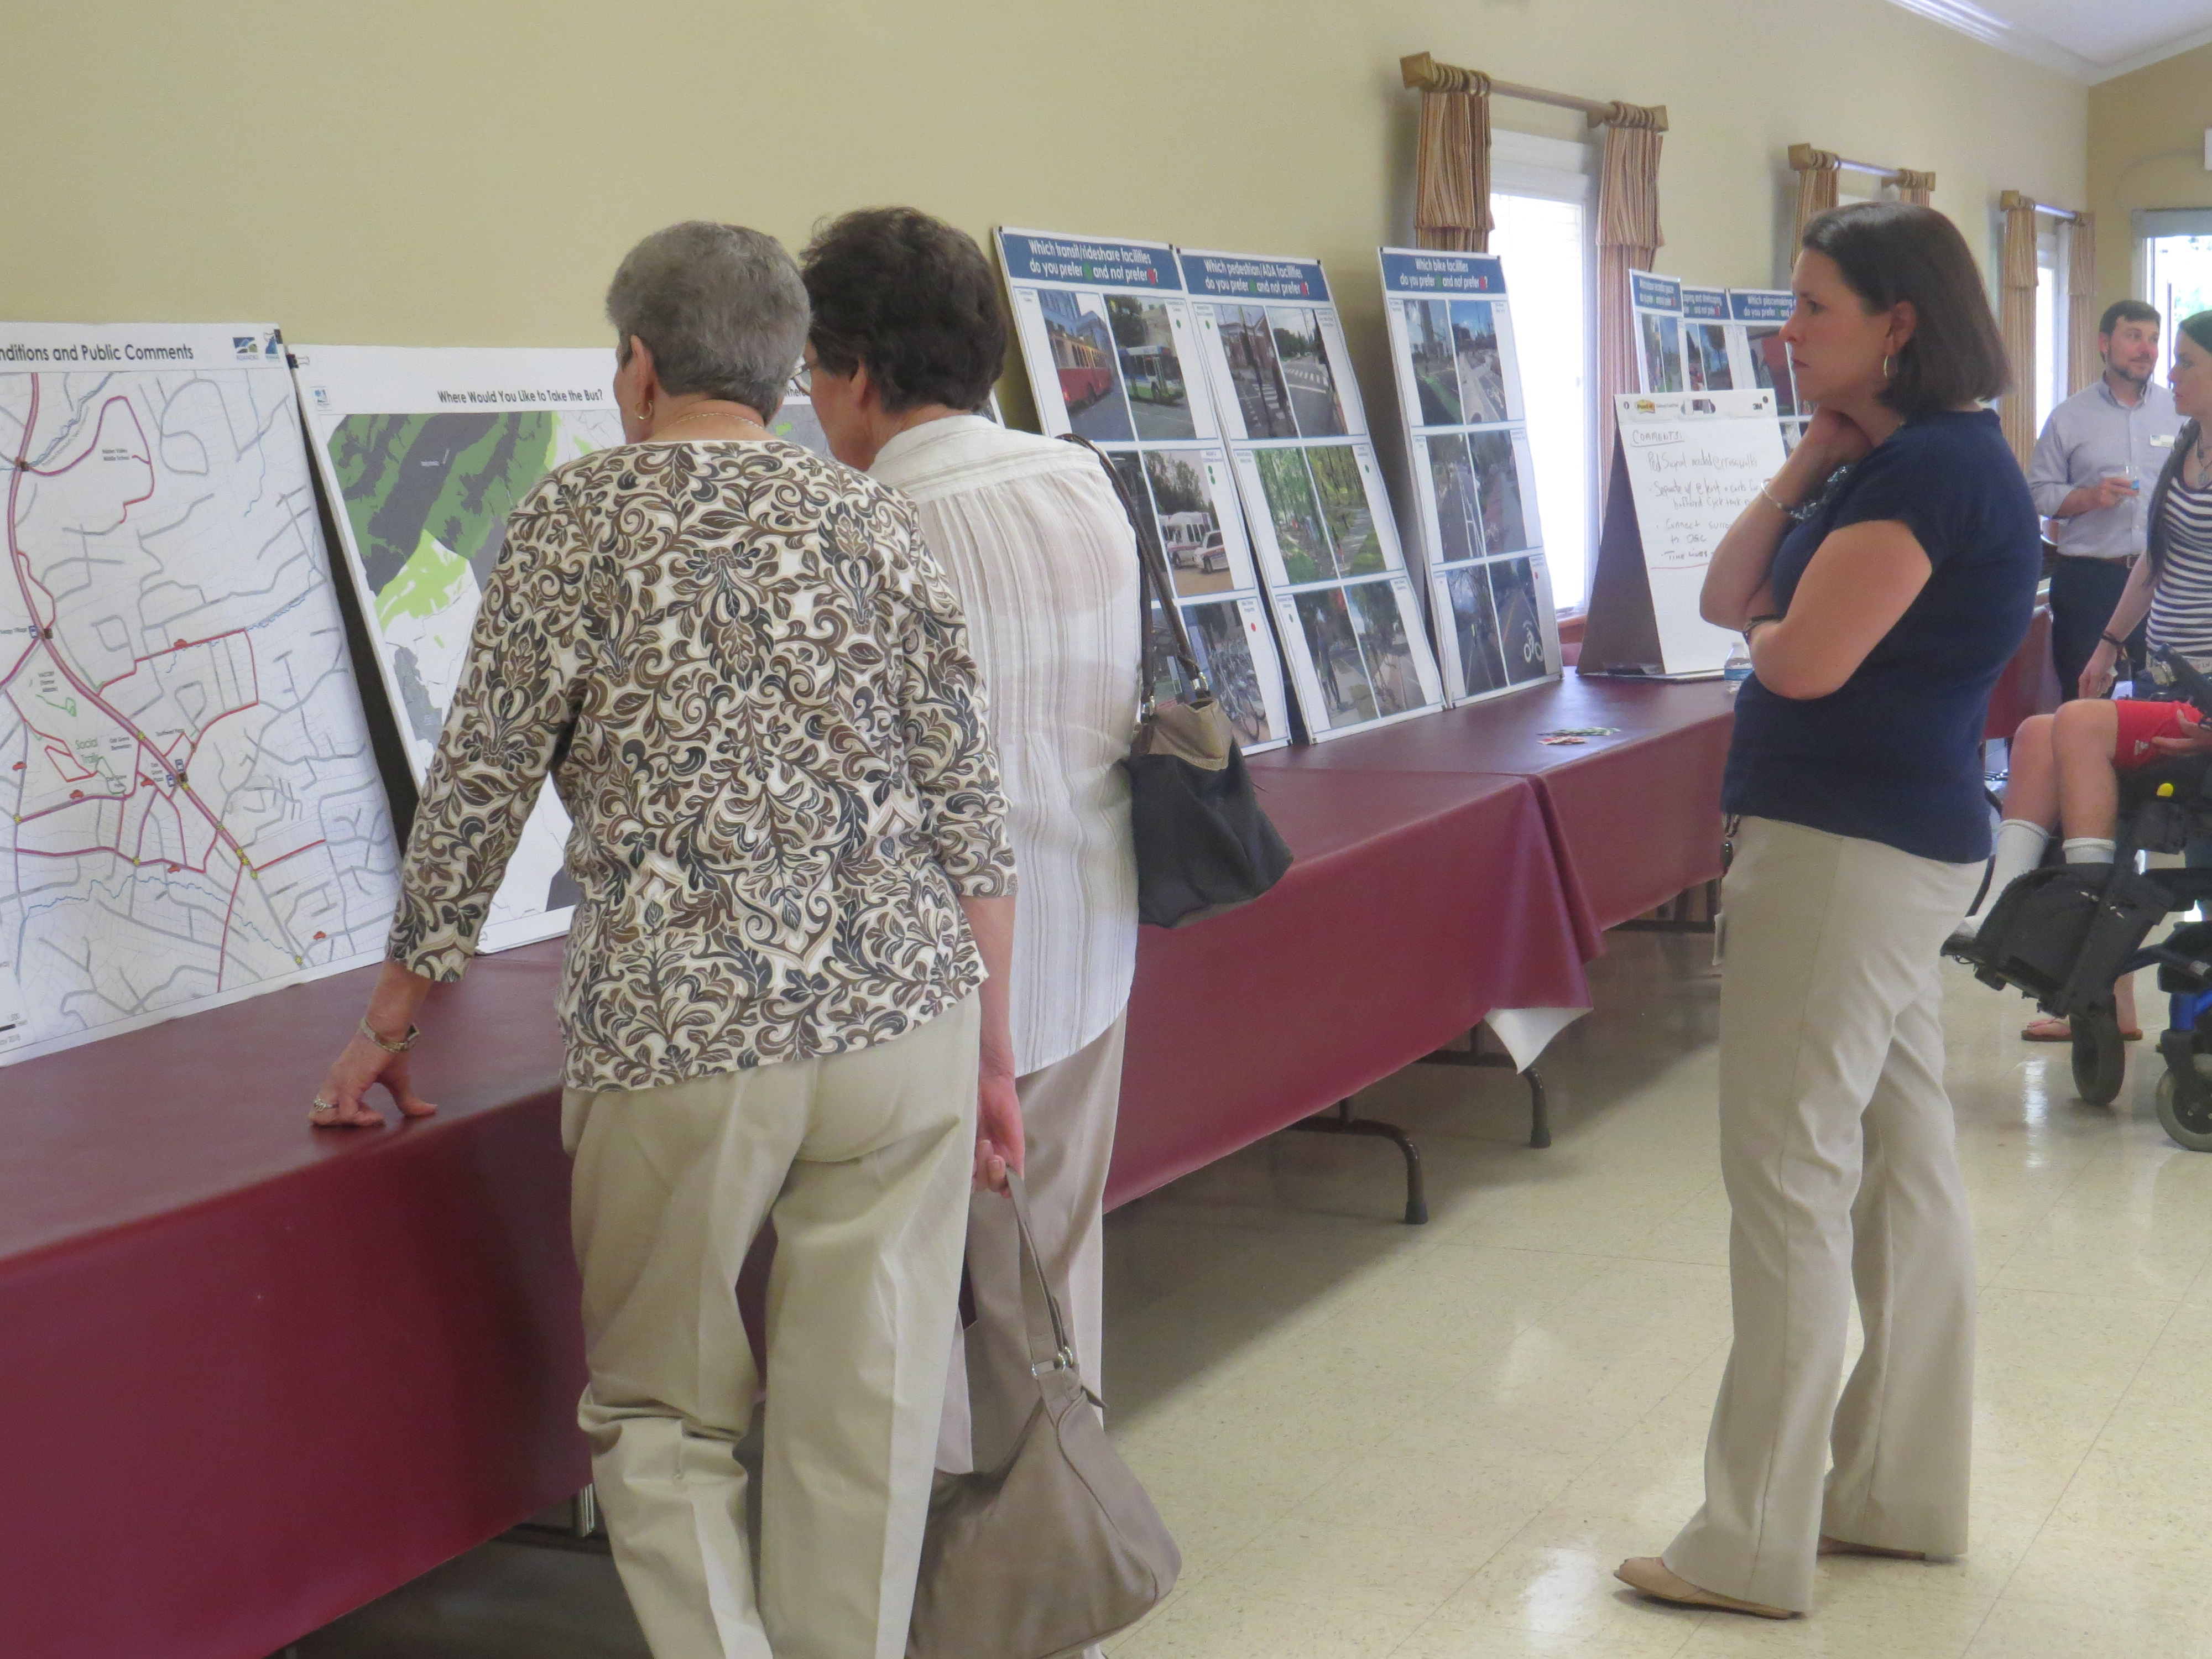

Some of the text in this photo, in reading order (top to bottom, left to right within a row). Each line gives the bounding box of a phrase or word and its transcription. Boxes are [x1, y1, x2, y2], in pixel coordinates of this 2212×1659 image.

[1028, 239, 1152, 265] Which transit/rideshare facilities
[1030, 258, 1041, 273] do
[1042, 262, 1058, 276] you
[1060, 262, 1083, 278] prefer
[1093, 265, 1108, 279] and
[1110, 265, 1124, 279] not
[1125, 267, 1148, 283] prefer
[1204, 259, 1303, 279] Which pedestrian/ADA facilities
[1415, 257, 1469, 272] Which bike facilities
[1205, 276, 1215, 290] do
[1215, 279, 1230, 293] you
[1230, 278, 1249, 293] prefer
[1256, 280, 1270, 293] and
[1270, 281, 1281, 293] not
[1281, 281, 1301, 296] prefer
[1400, 272, 1408, 285] do
[1409, 275, 1418, 289] you
[1419, 274, 1435, 289] prefer
[1442, 275, 1453, 287] and
[1454, 275, 1463, 288] not
[1464, 275, 1479, 289] prefer
[53, 345, 78, 361] and
[82, 344, 121, 361] Public
[125, 343, 194, 360] Comments
[437, 389, 603, 403] Where Would You Like to Take the Bus?
